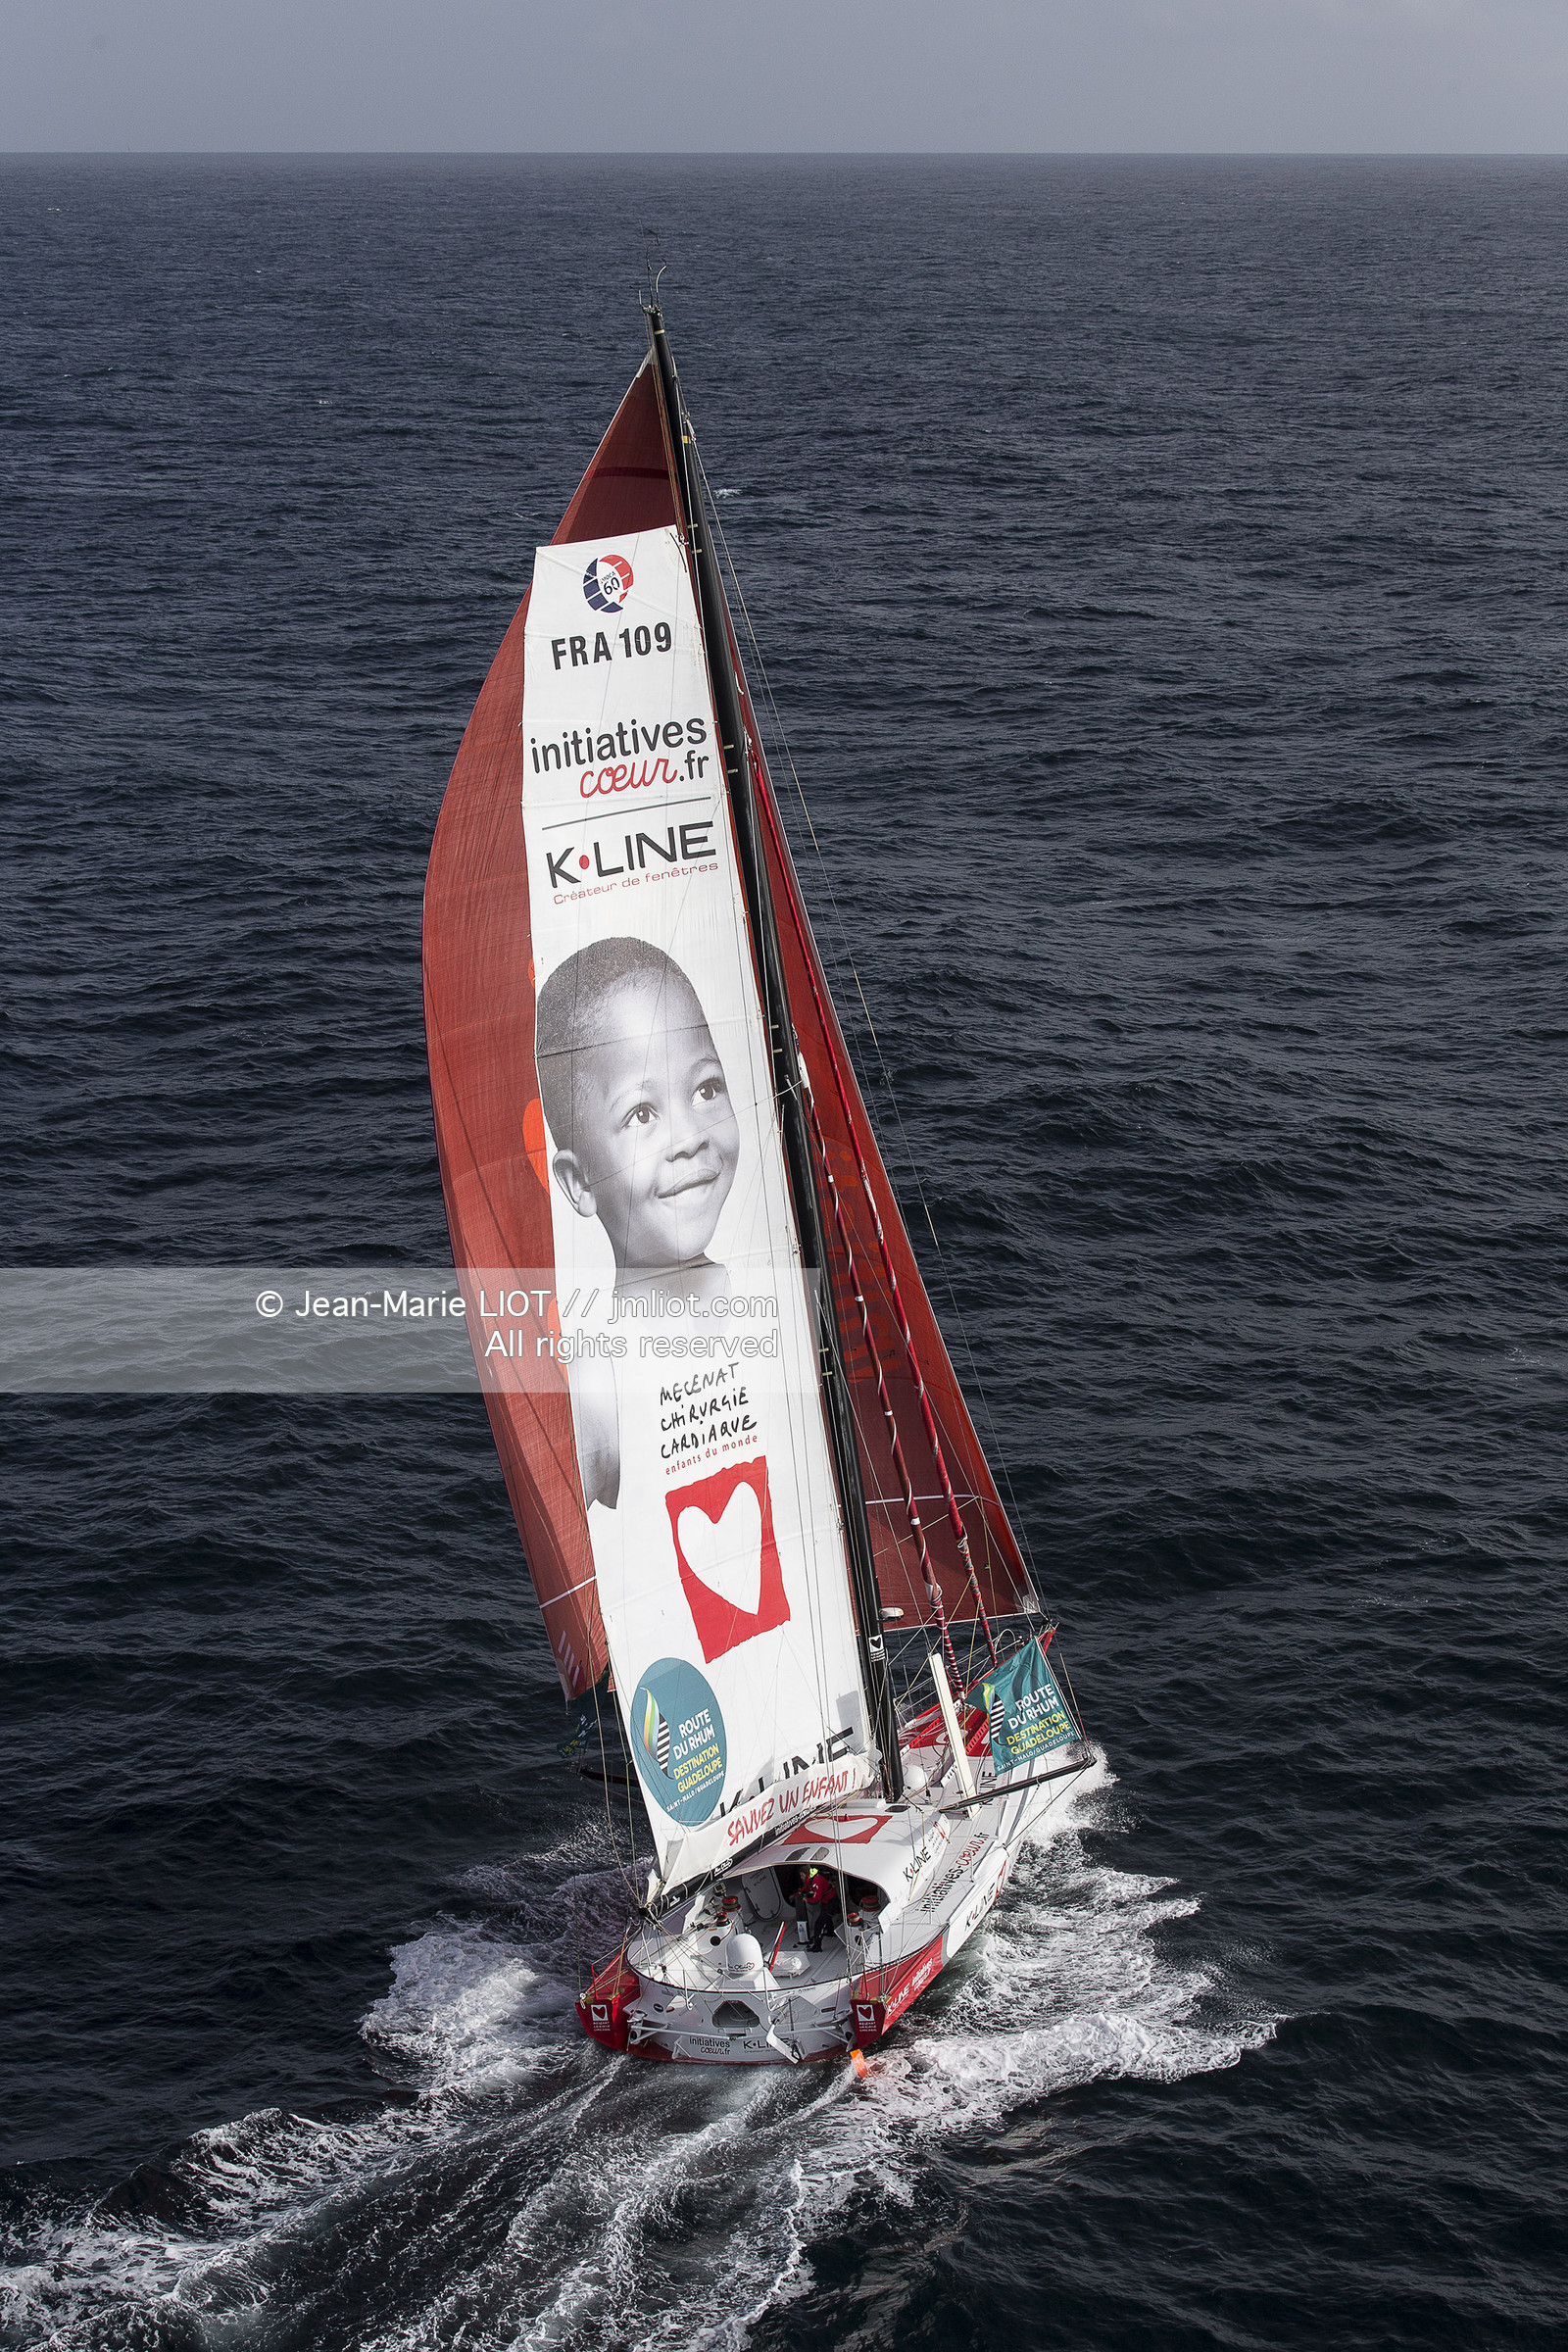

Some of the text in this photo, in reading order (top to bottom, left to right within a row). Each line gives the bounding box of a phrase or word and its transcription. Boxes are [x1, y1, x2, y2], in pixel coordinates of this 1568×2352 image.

[604, 577, 619, 595] 60
[551, 622, 672, 670] FRA 109
[531, 717, 707, 774] initiatives
[553, 862, 718, 906] Créateur de fenêtres
[660, 1361, 740, 1406] MECENAT
[661, 1414, 758, 1459] CARDIAQUE
[665, 1434, 758, 1476] enfants du monde
[1007, 1695, 1059, 1730] DU RHUM
[1014, 1683, 1054, 1712] ROUTE
[672, 1723, 716, 1761] DU RHUM
[678, 1707, 711, 1739] ROUTE
[1005, 1710, 1066, 1745] DESTINATION
[1010, 1720, 1071, 1755] GUADELOUPE
[673, 1742, 719, 1780] DESTINATION
[677, 1756, 723, 1793] GUADELOUPE
[727, 1767, 857, 1846] SAUVEZ UN ENFANT !
[689, 2035, 730, 2048] initiatives
